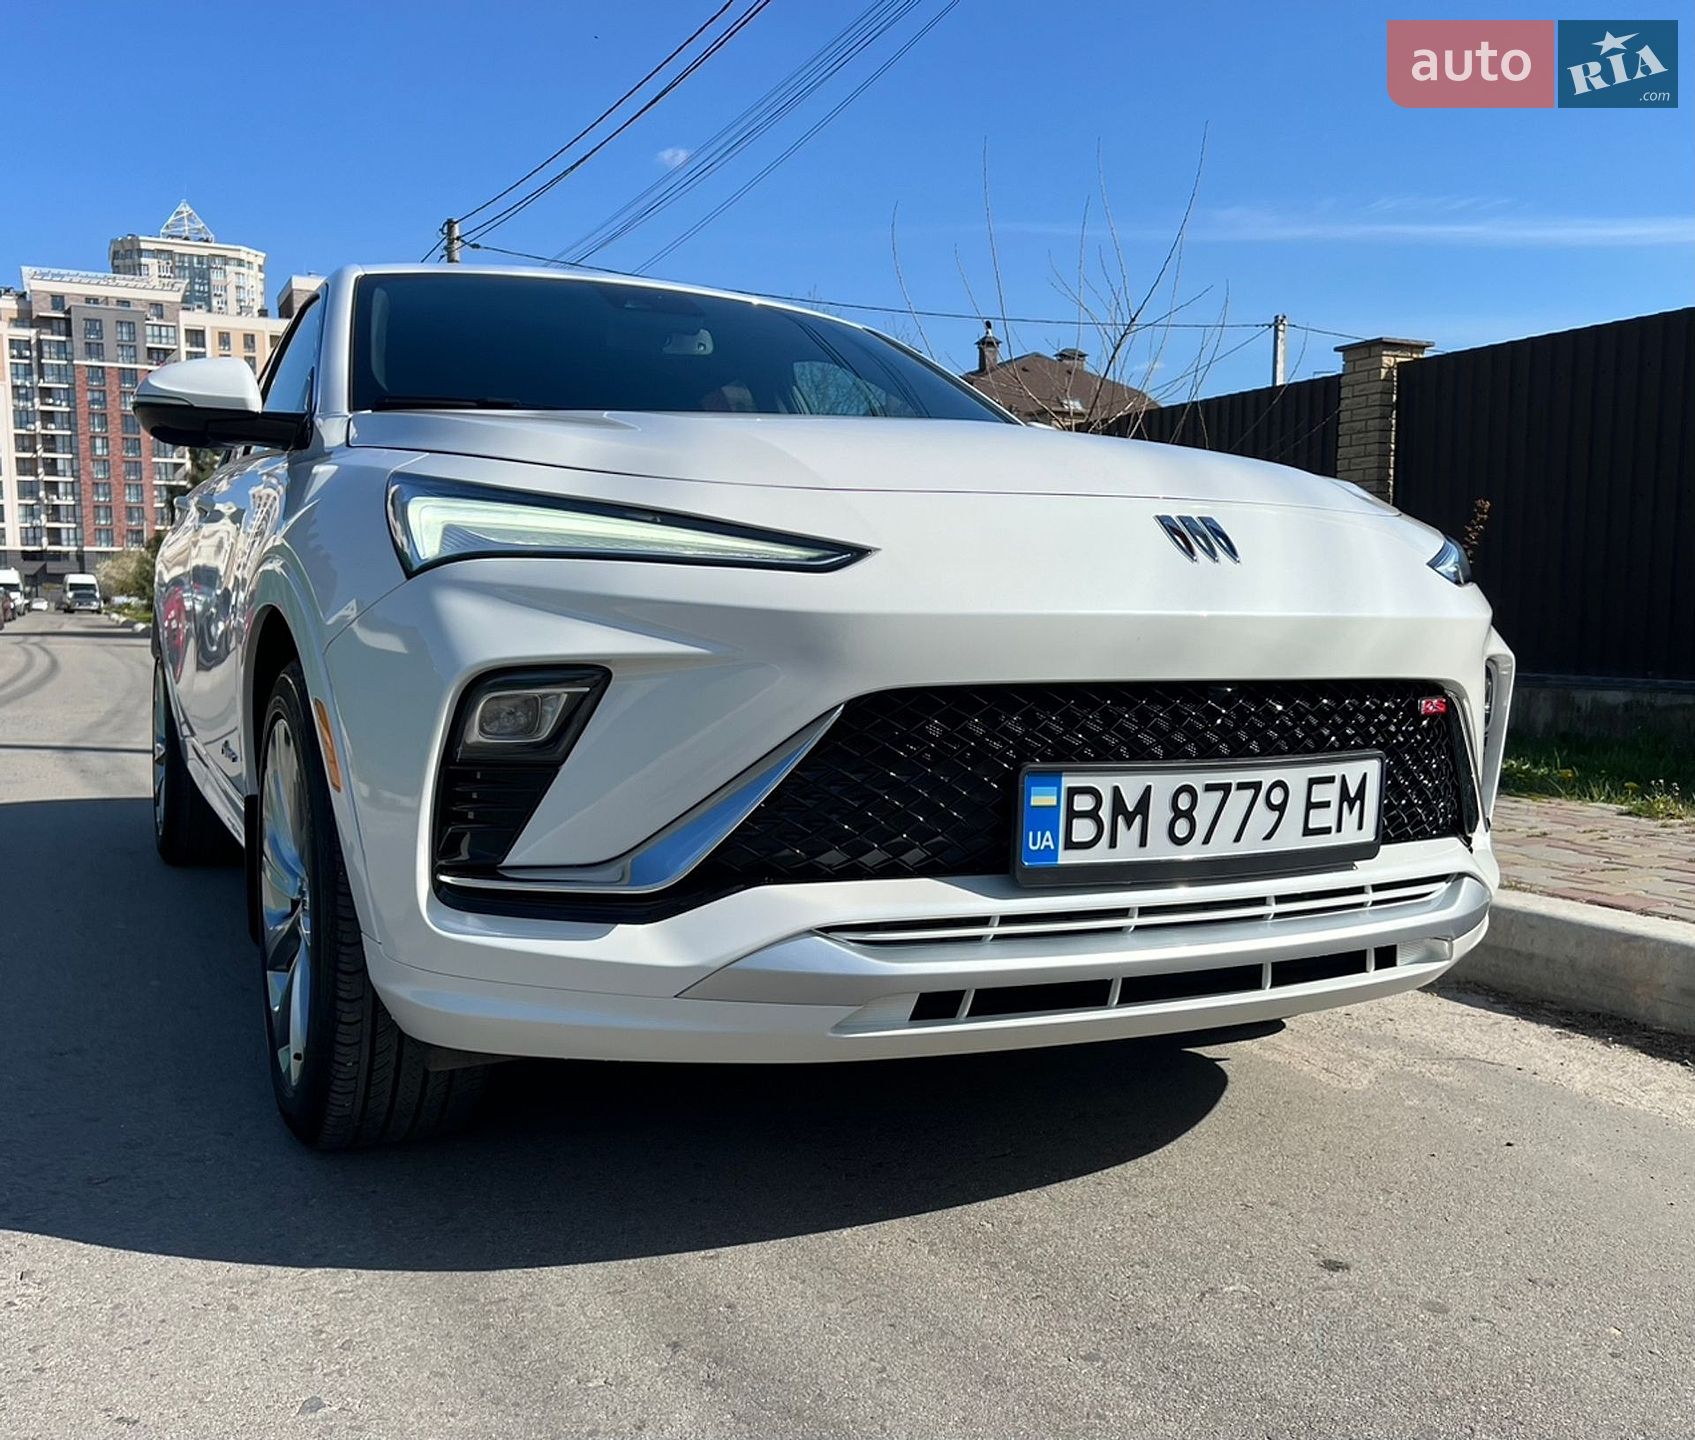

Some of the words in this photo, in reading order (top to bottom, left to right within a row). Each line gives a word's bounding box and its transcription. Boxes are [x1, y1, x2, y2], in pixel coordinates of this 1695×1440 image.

[1063, 784, 1153, 851] BM
[1167, 779, 1290, 847] 8779
[1302, 771, 1368, 838] EM
[1028, 831, 1055, 851] UA
